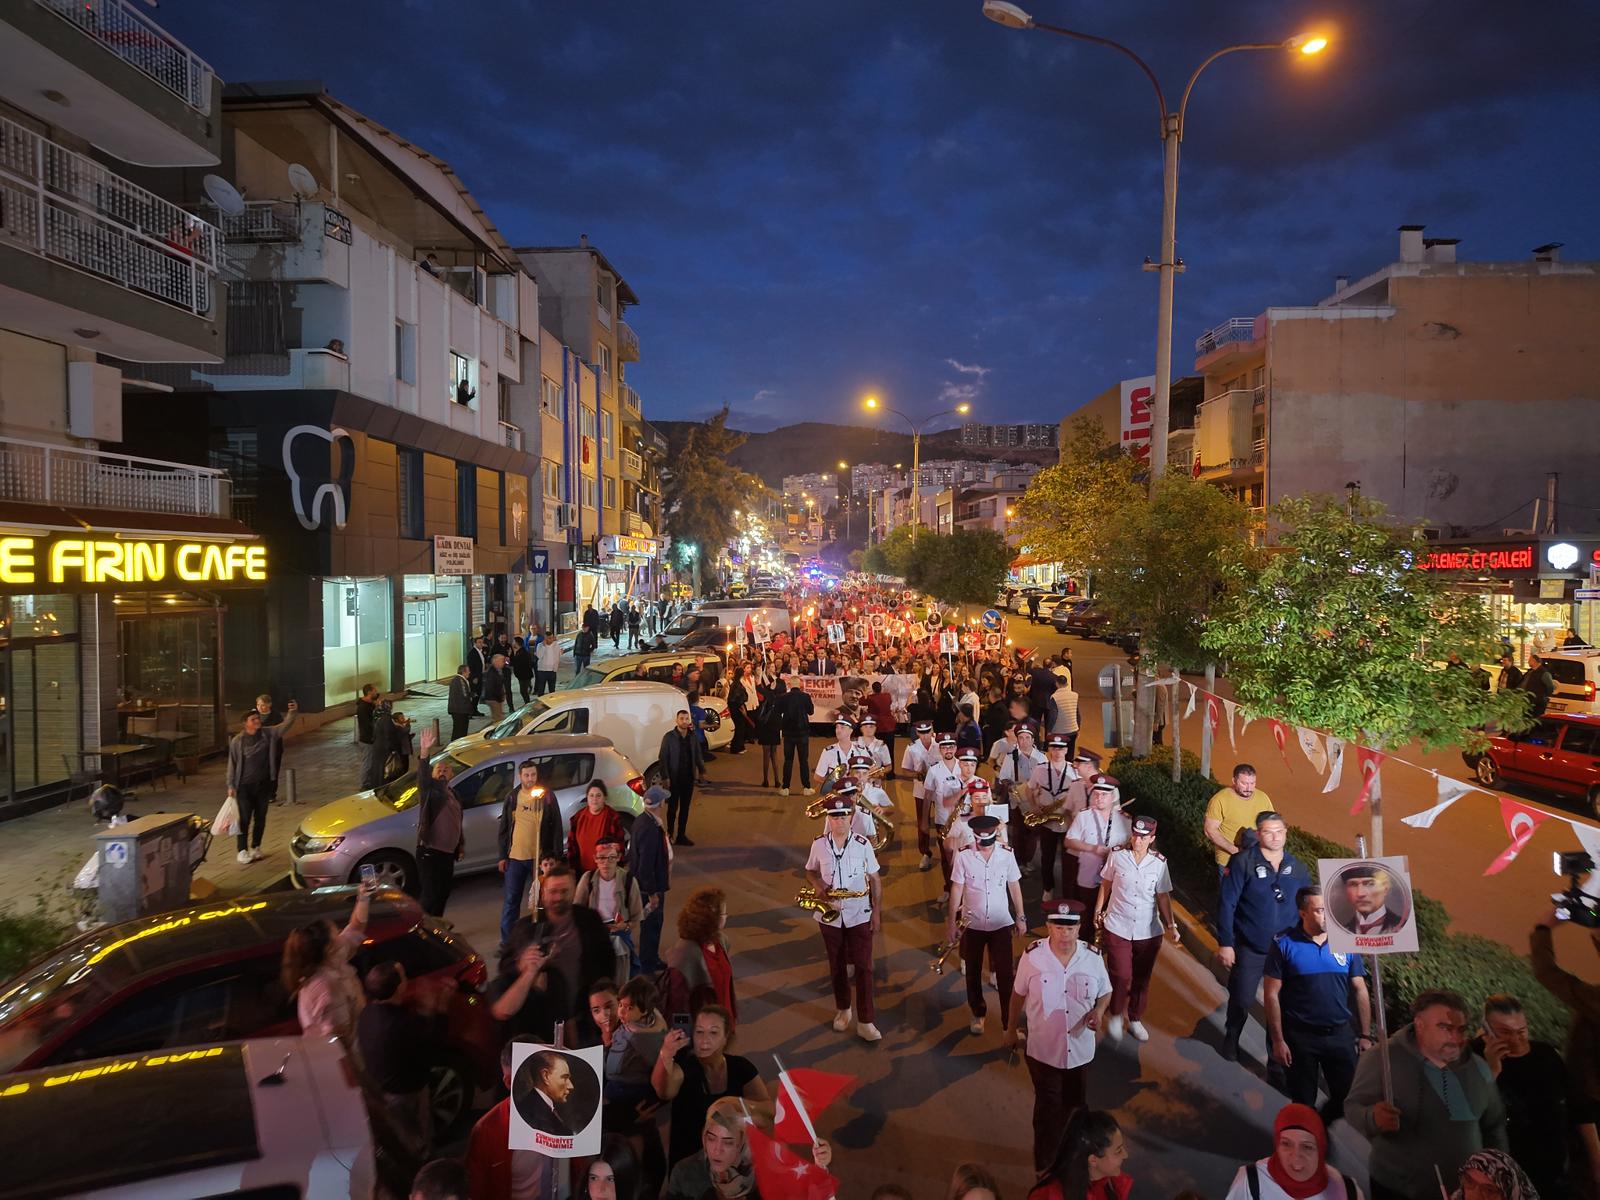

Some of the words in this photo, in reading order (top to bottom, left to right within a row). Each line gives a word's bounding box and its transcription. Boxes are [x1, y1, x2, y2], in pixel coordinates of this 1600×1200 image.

[454, 541, 472, 550] DENTAL
[0, 537, 35, 583] E
[51, 540, 165, 583] FIRIN
[176, 544, 266, 581] CAFE
[1472, 552, 1485, 569] ET
[1489, 546, 1532, 569] GALERİ
[805, 679, 835, 688] EKİM
[536, 1132, 573, 1144] CUMHURİYET
